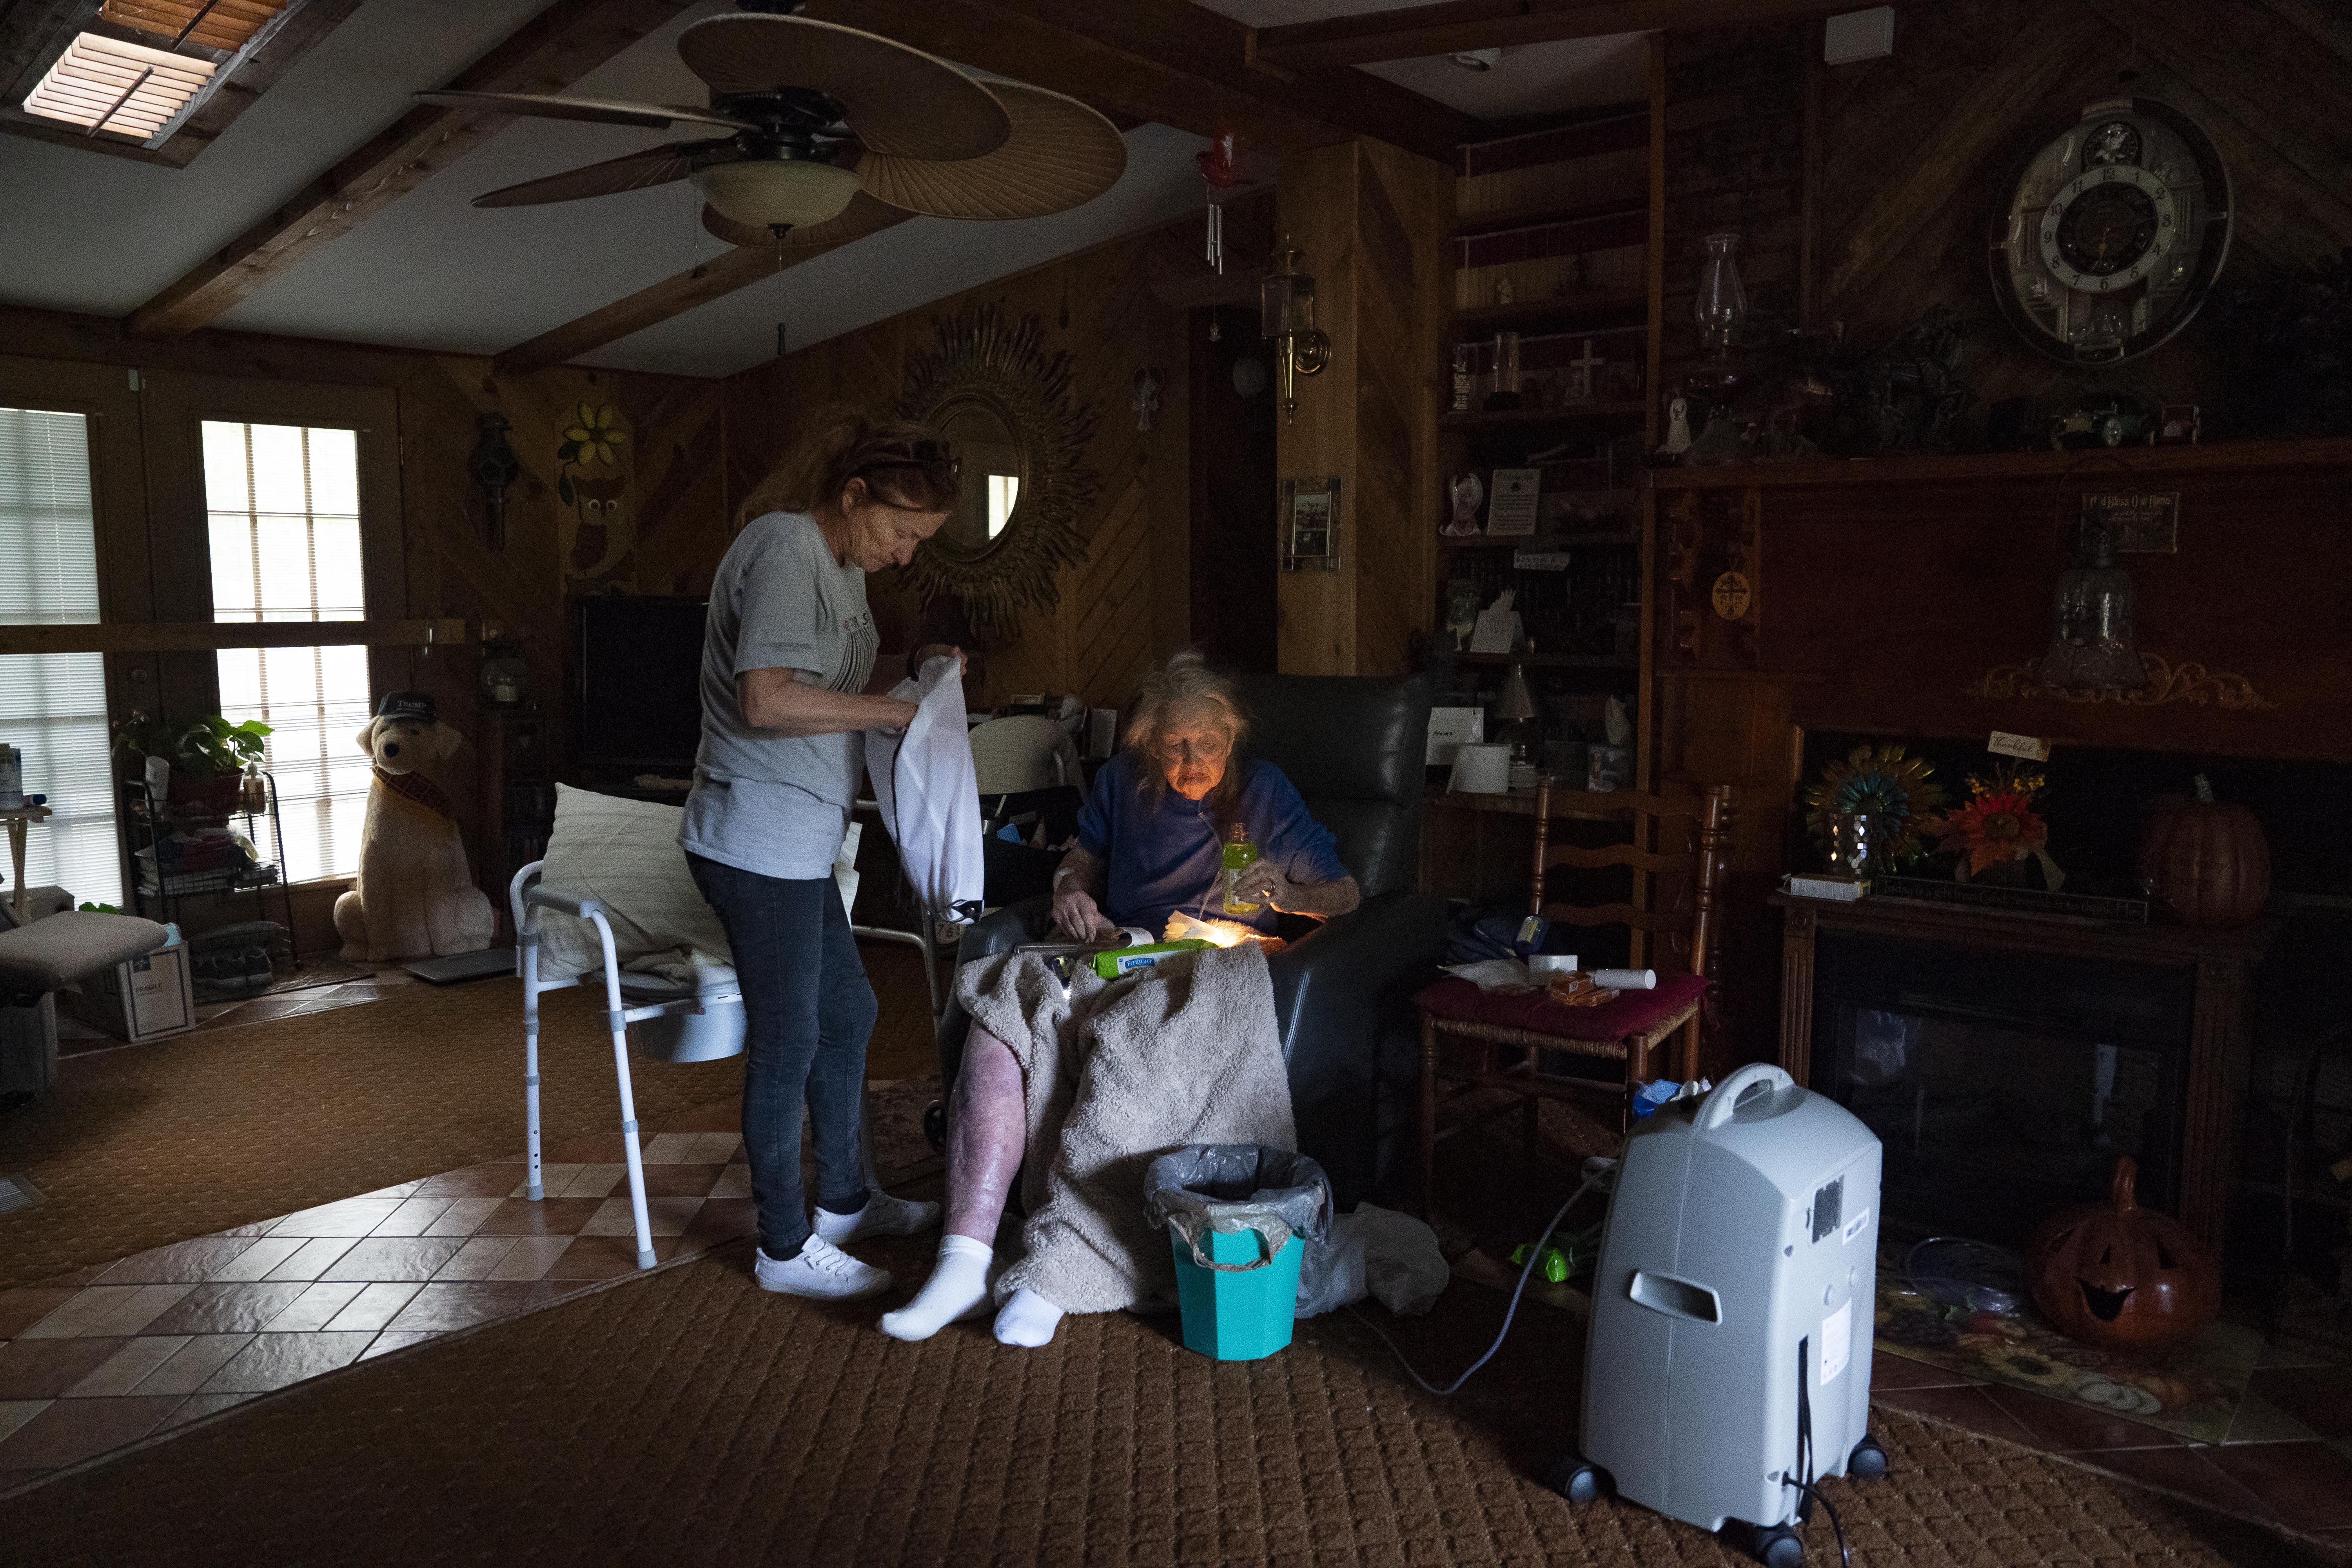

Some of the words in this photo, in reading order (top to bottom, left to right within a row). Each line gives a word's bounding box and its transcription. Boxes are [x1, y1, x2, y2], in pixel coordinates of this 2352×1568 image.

[2103, 168, 2115, 180] 12
[2135, 173, 2139, 182] 1
[2072, 180, 2082, 193] 11
[2156, 187, 2165, 200] 2
[2051, 203, 2062, 216] 10
[2162, 214, 2171, 227] 3
[2044, 232, 2052, 243] 9
[2152, 244, 2160, 255] 4
[2052, 257, 2060, 269] 8
[2130, 267, 2139, 278] 5
[2073, 275, 2080, 285] 7
[2100, 278, 2108, 290] 6
[397, 700, 426, 708] TRUMP
[1993, 735, 2035, 753] Thankful
[1881, 879, 1913, 897] Today
[136, 983, 162, 993] FRAGILE
